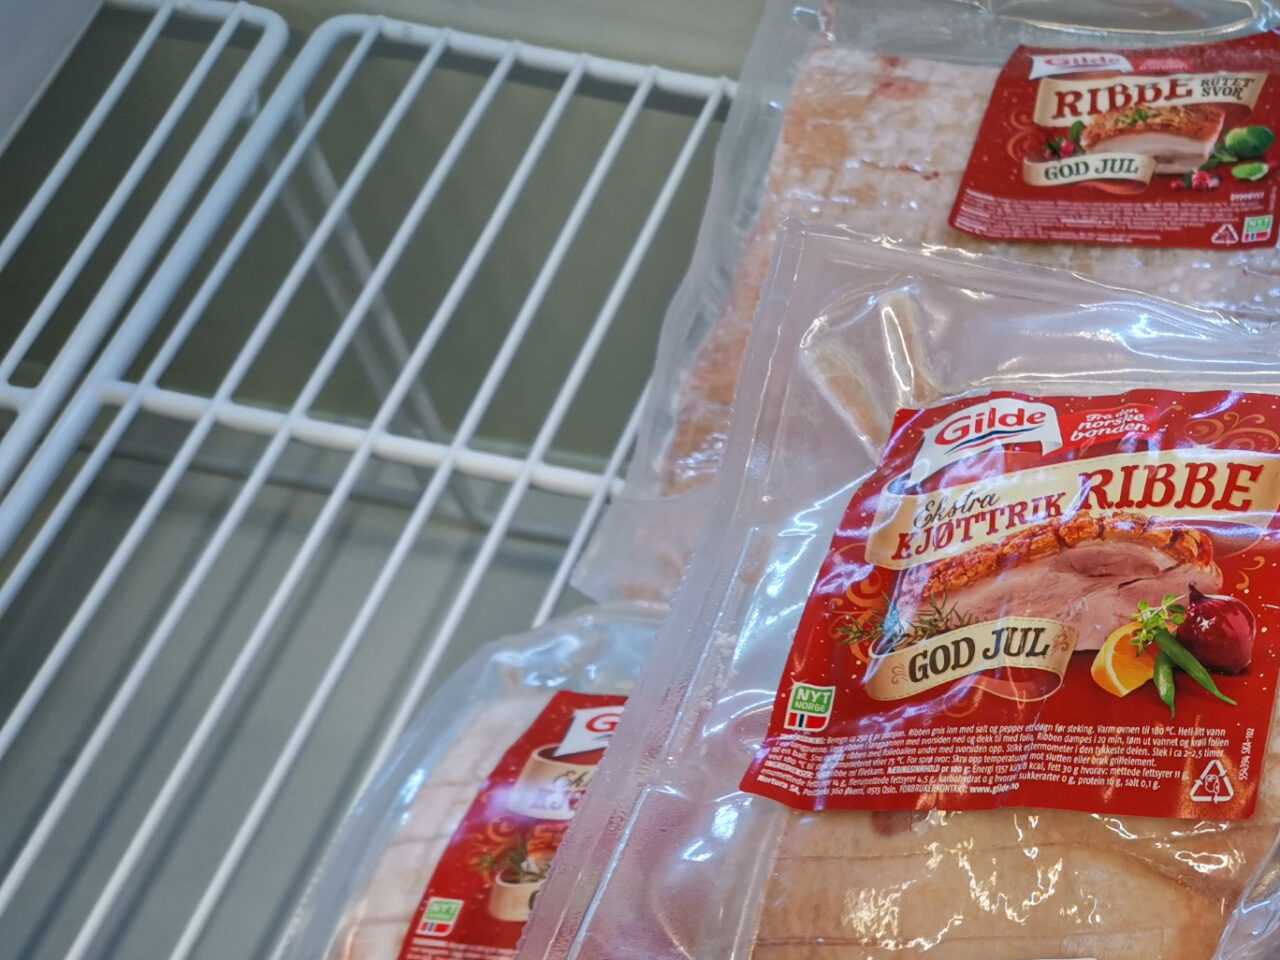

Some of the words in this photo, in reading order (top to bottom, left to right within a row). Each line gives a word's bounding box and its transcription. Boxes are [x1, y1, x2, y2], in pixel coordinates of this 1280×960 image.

[1045, 161, 1089, 180] GOD
[1095, 157, 1139, 175] JUL
[1078, 413, 1145, 430] norske
[1086, 413, 1113, 422] Fra
[1115, 407, 1139, 419] den
[935, 407, 1046, 446] Gilde
[1070, 422, 1149, 442] bonden
[892, 492, 1067, 561] KJØTTRIK
[1079, 462, 1264, 512] RIBBE
[913, 489, 1001, 529] Ekstra
[908, 636, 976, 683] GOD
[982, 627, 1050, 660] JUL
[796, 688, 831, 702] NYT
[794, 700, 826, 712] NORGE
